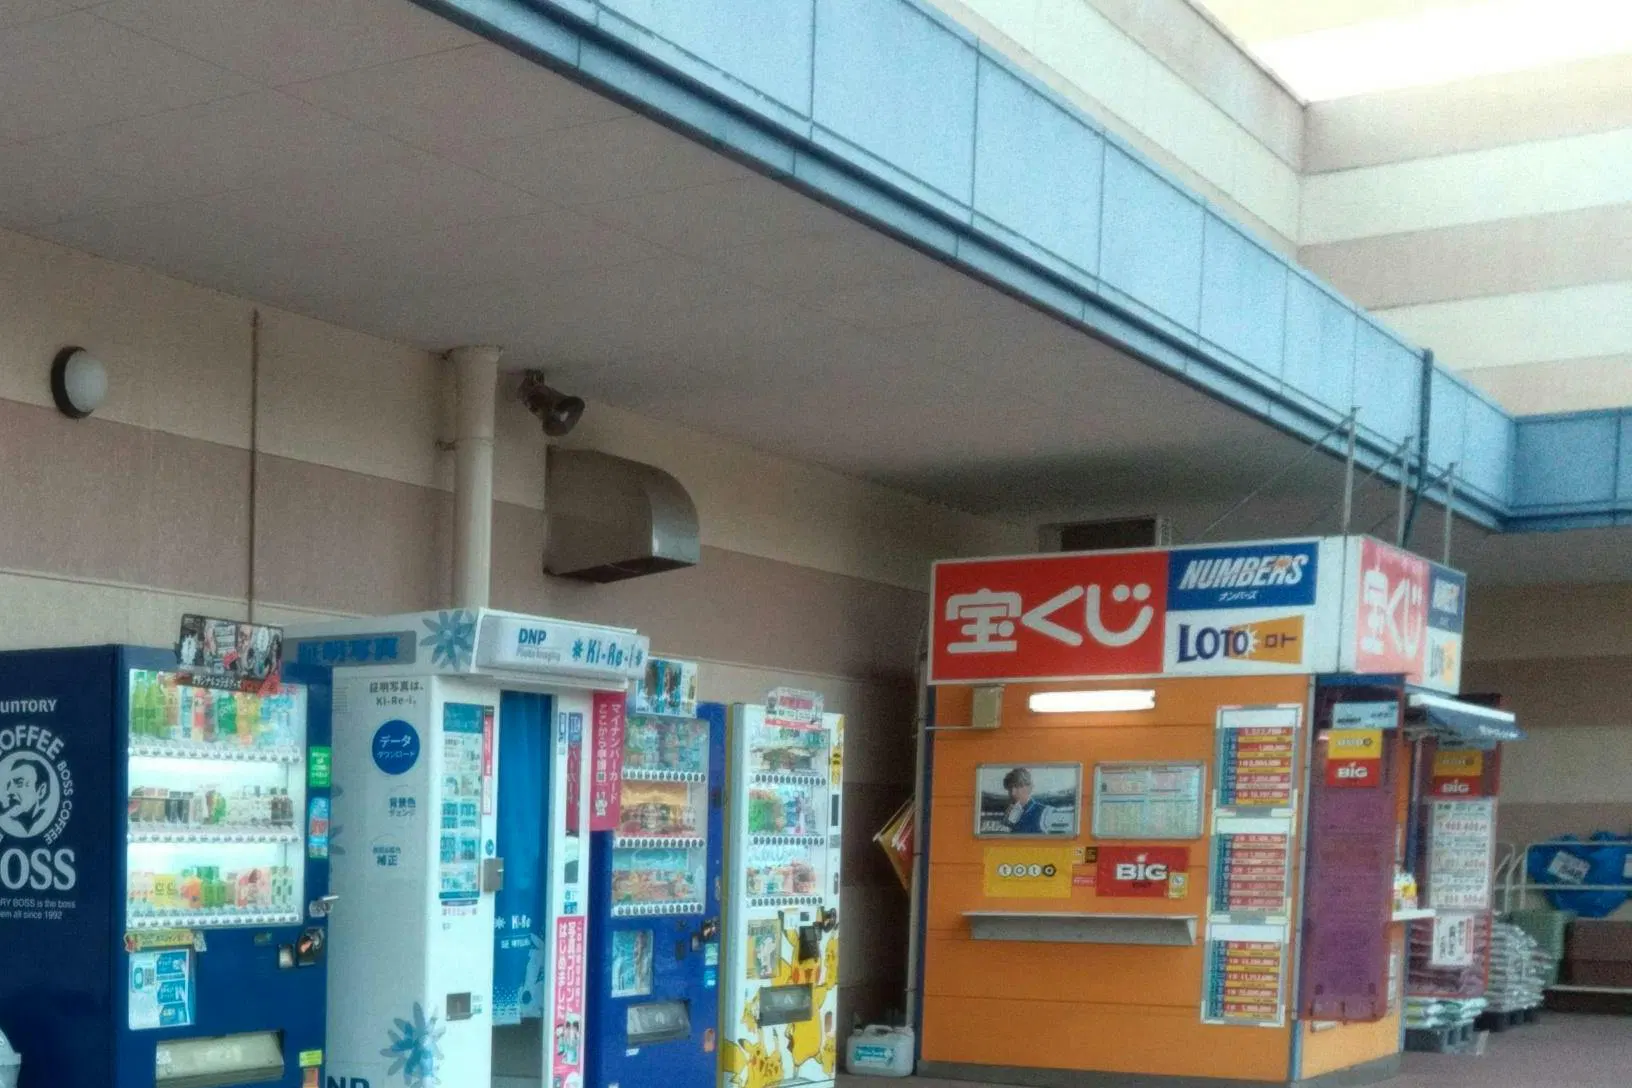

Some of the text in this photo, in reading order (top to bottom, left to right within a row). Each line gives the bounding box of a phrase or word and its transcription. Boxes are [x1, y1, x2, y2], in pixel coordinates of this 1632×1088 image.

[1178, 553, 1310, 590] NUMBERS
[945, 582, 1154, 655] 宝くじ
[1360, 569, 1423, 663] 宝くじ
[518, 628, 547, 645] DNP
[1177, 623, 1249, 664] LOTO
[1264, 632, 1298, 649] ロト
[380, 734, 412, 749] データ
[43, 761, 74, 845] BOSS COFFEE
[998, 863, 1057, 878] toto
[13, 897, 35, 909] BOSS
[37, 899, 43, 908] is
[45, 899, 57, 908] the
[58, 899, 76, 909] boss
[24, 909, 43, 919] since
[45, 909, 63, 920] 1992
